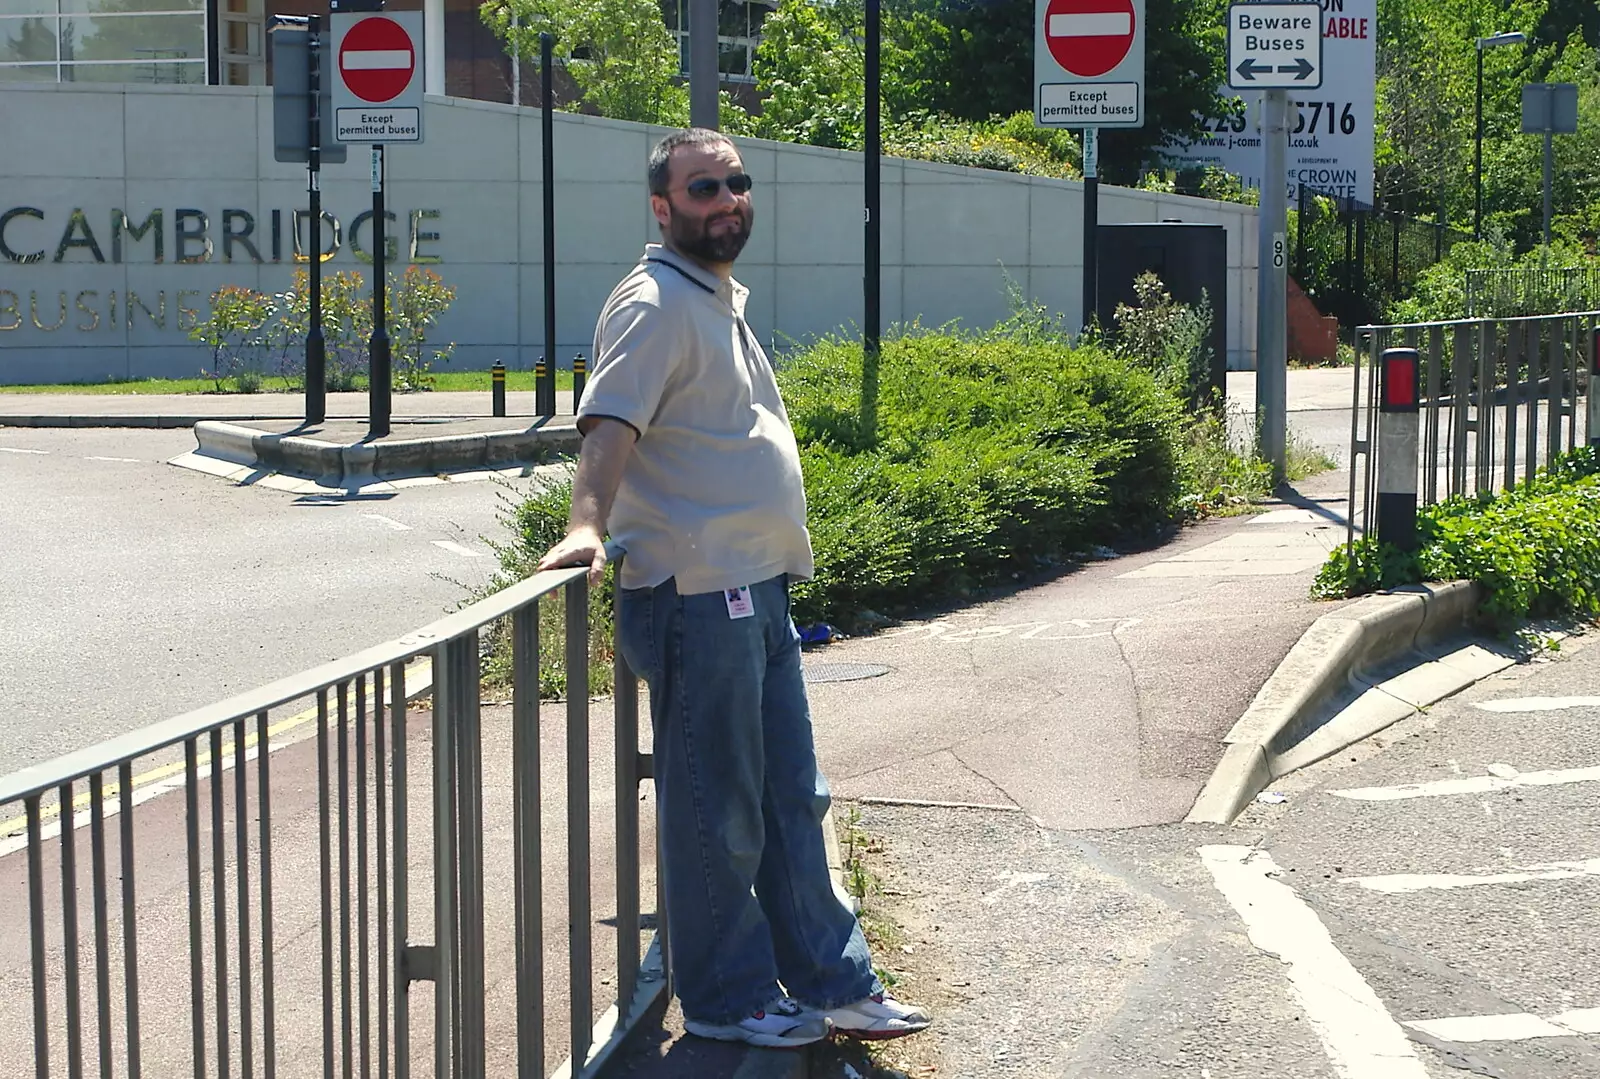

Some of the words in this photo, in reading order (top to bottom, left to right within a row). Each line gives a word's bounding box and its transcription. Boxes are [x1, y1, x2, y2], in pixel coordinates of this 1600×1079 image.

[1239, 15, 1312, 30] Beware
[1323, 17, 1368, 39] ABLE
[1245, 35, 1305, 51] Buses
[1069, 91, 1108, 103] Except
[1043, 104, 1097, 117] permitted
[1101, 104, 1134, 115] buses
[361, 114, 393, 124] Except
[340, 125, 385, 136] permitted
[388, 125, 416, 134] buses
[1298, 169, 1357, 184] CROWN
[0, 206, 444, 264] CAMBRIDGE
[1274, 240, 1283, 267] 90
